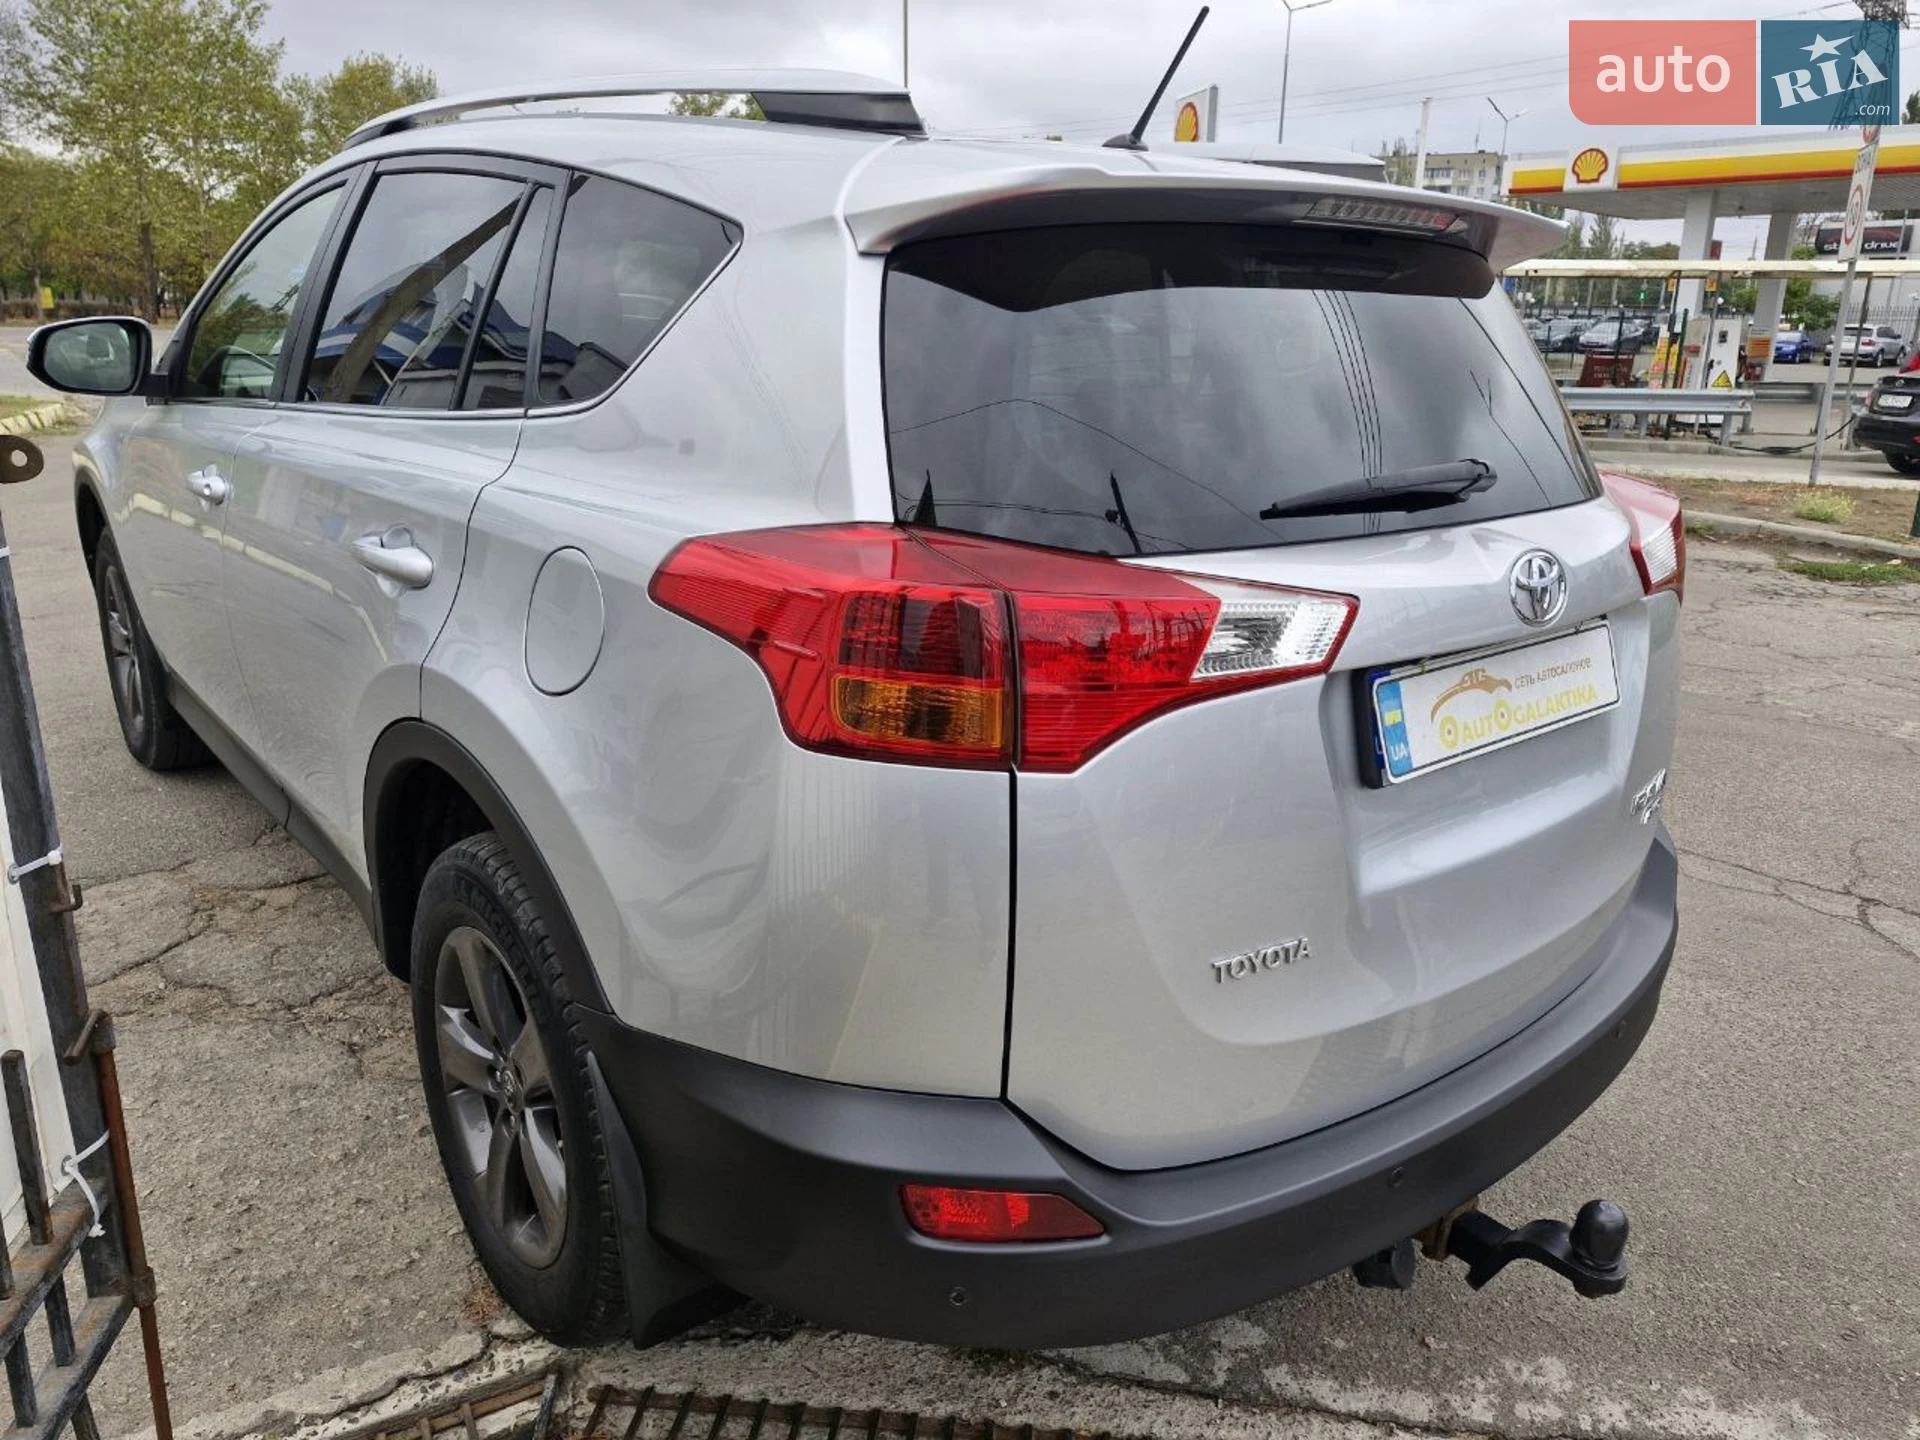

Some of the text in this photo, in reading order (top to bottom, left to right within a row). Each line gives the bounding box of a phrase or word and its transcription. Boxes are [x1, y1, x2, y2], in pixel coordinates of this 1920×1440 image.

[1514, 657, 1593, 689] СЕТЬ АВТОСАЛОНОВ
[1390, 743, 1408, 761] UA
[1211, 936, 1313, 984] TOYOTA
